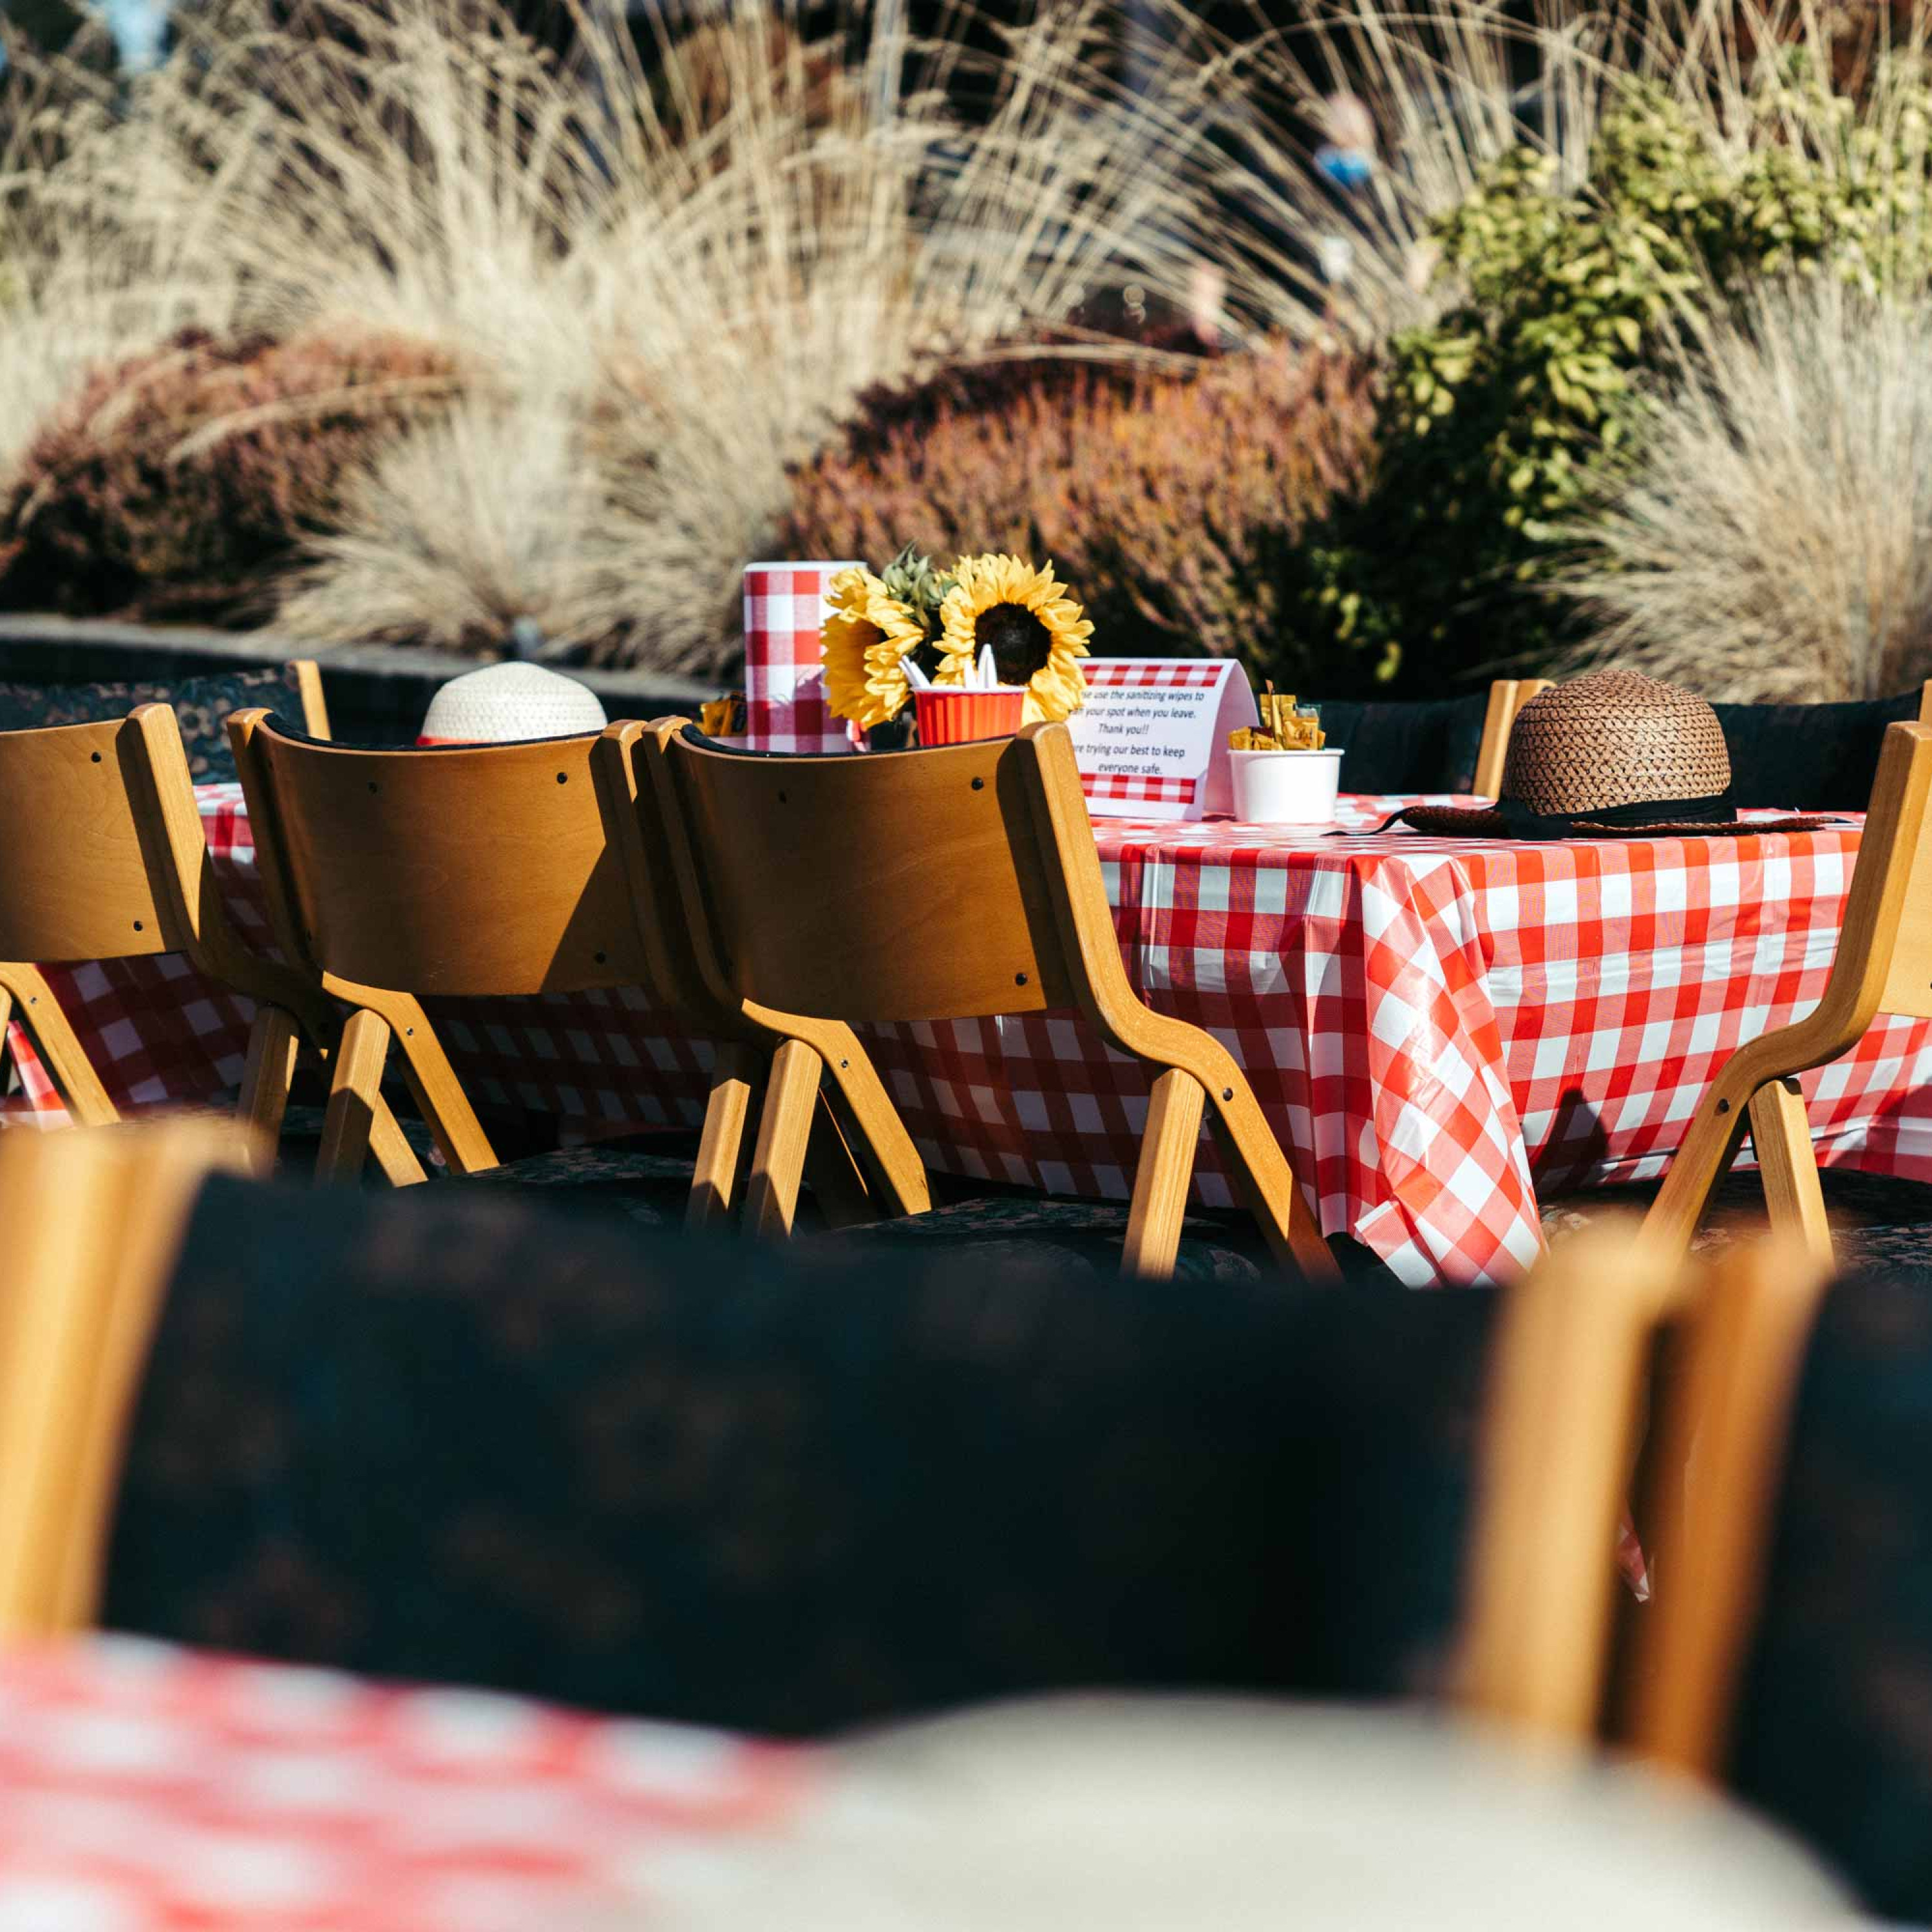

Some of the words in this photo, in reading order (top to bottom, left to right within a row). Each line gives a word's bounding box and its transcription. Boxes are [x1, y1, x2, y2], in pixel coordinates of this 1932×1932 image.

[1110, 689, 1125, 700] the
[1126, 689, 1166, 702] sanitizing
[1168, 690, 1193, 703] wipes
[1195, 691, 1205, 701] to
[1085, 708, 1106, 717] your
[1106, 707, 1126, 718] spot
[1126, 706, 1151, 717] when
[1151, 709, 1170, 719] you
[1171, 707, 1197, 719] leave.
[1098, 723, 1123, 734] Thank
[1124, 723, 1150, 736] you!!
[1086, 743, 1112, 756] trying
[1113, 745, 1128, 754] our
[1130, 744, 1150, 755] best
[1151, 746, 1161, 756] to
[1162, 745, 1186, 760] keep
[1098, 763, 1139, 775] everyone
[1141, 762, 1163, 775] safe.
